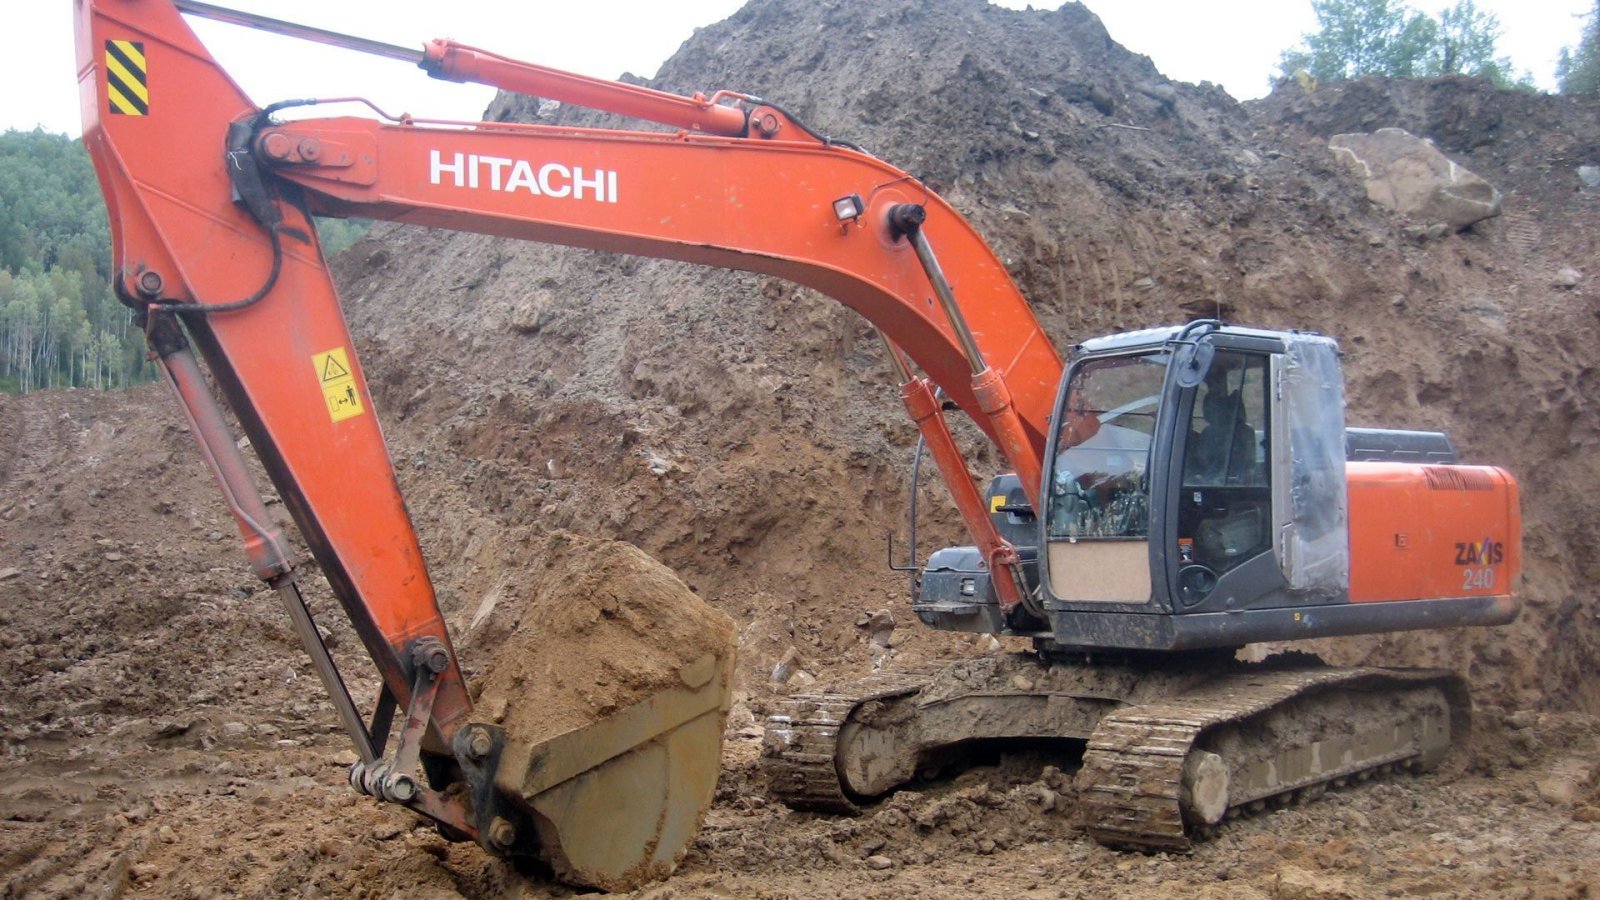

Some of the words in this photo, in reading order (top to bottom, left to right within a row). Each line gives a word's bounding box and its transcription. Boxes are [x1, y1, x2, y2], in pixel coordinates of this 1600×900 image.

[430, 150, 618, 203] HITACHI
[1455, 536, 1503, 566] ZAXIS
[1463, 568, 1494, 590] 240
